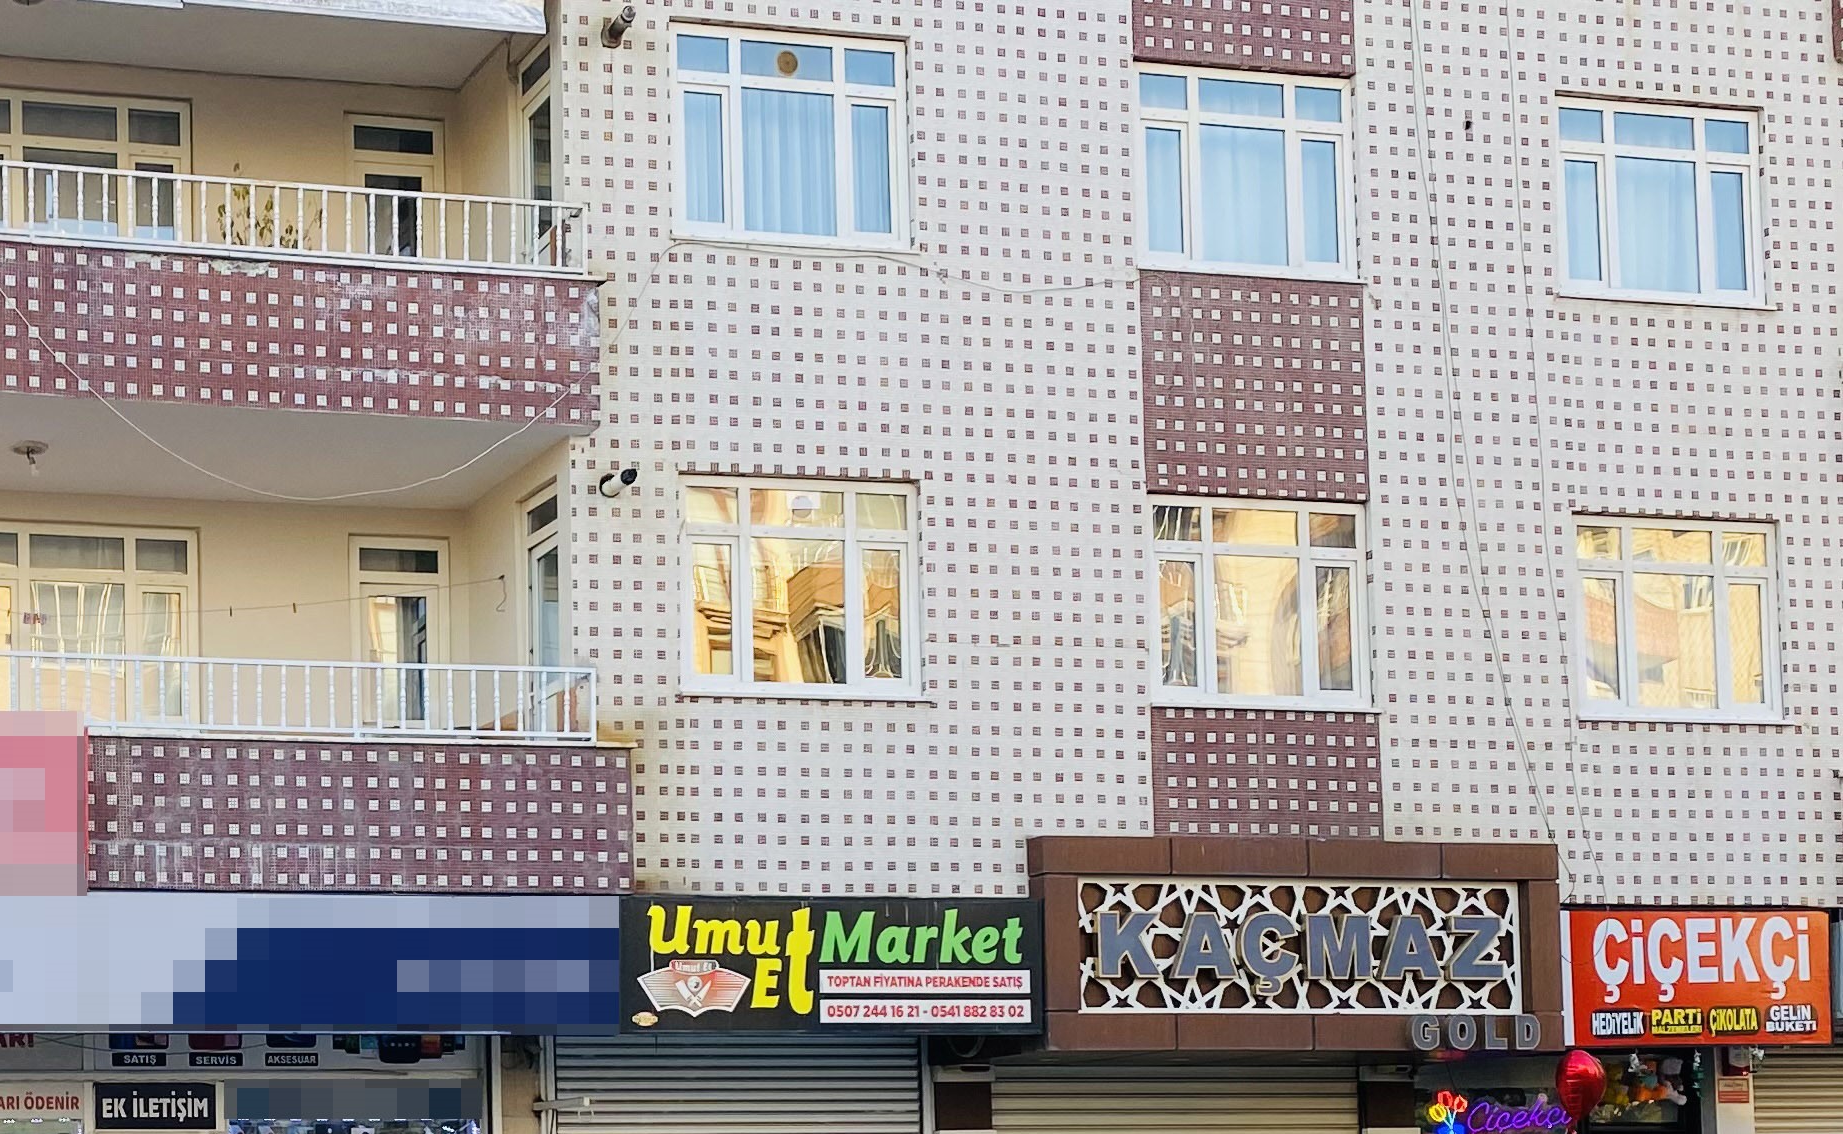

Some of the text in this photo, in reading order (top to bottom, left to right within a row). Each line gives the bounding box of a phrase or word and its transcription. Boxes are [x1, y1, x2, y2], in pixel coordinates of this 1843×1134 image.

[818, 907, 1024, 965] Market
[1093, 910, 1505, 997] KAÇMAZ
[827, 975, 871, 988] TOPTAN
[925, 975, 990, 988] PERAKENDE
[992, 975, 1023, 991] SATIŞ
[827, 1005, 860, 1018] 0507
[863, 1005, 887, 1018] 244
[891, 1005, 904, 1018] 16
[907, 1005, 920, 1018] 21
[931, 1005, 961, 1018] 0541
[963, 1005, 987, 1018] 882
[989, 1005, 1005, 1018] 83
[1008, 1005, 1024, 1018] 02
[1411, 1013, 1542, 1052] GOLD
[123, 1054, 156, 1066] SATIŞ
[267, 1055, 316, 1064] AKSESUAR
[102, 1090, 208, 1122] EK İLETİŞİM
